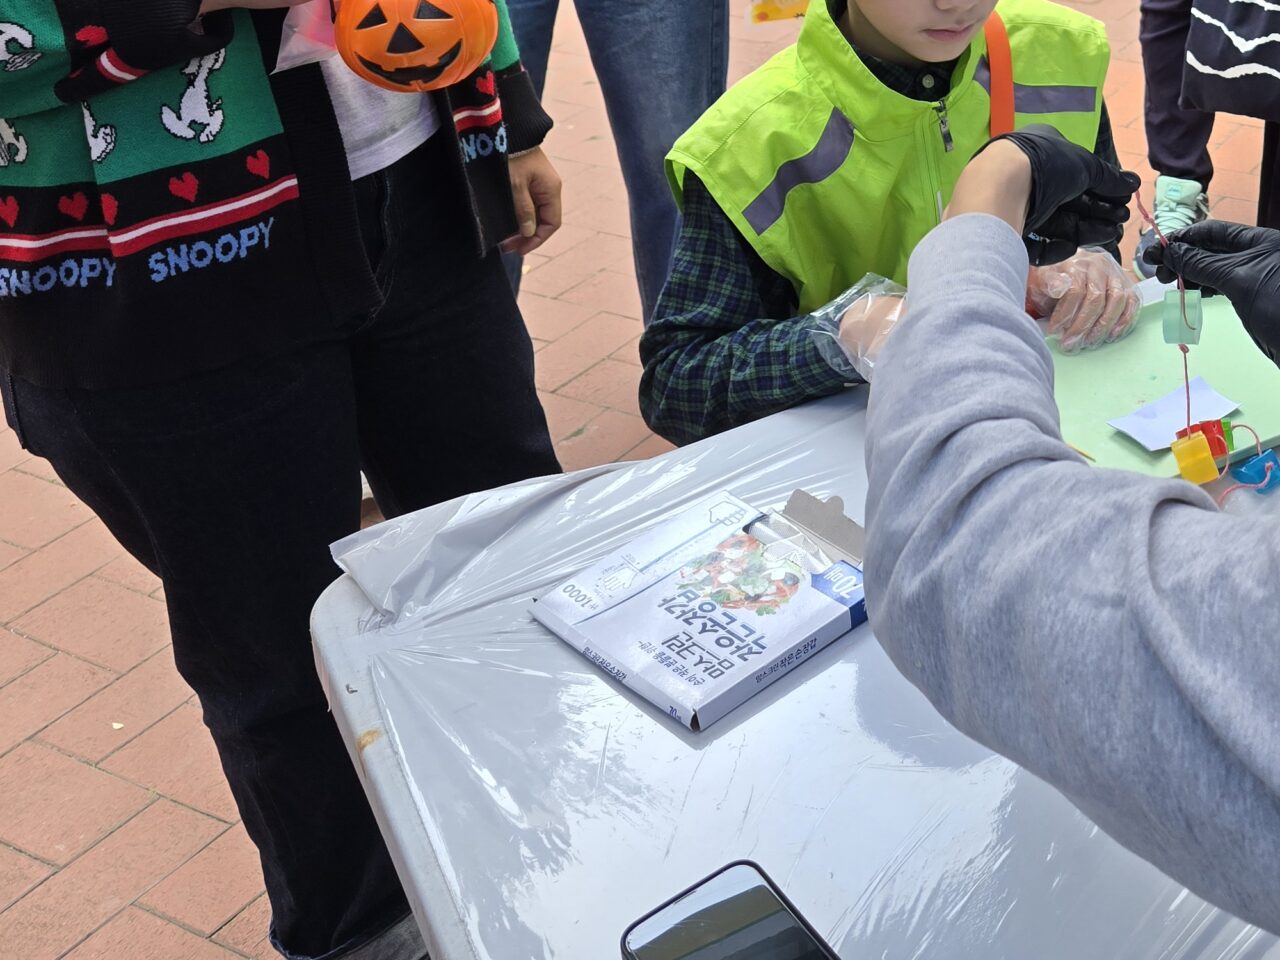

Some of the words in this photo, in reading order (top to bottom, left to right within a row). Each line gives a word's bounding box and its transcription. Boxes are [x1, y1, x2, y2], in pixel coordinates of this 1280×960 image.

[148, 217, 274, 283] SNOOPY
[0, 257, 116, 297] SNOOPY
[823, 565, 863, 599] 70매
[657, 589, 768, 662] 작은손장갑
[661, 631, 735, 680] 맘스크린
